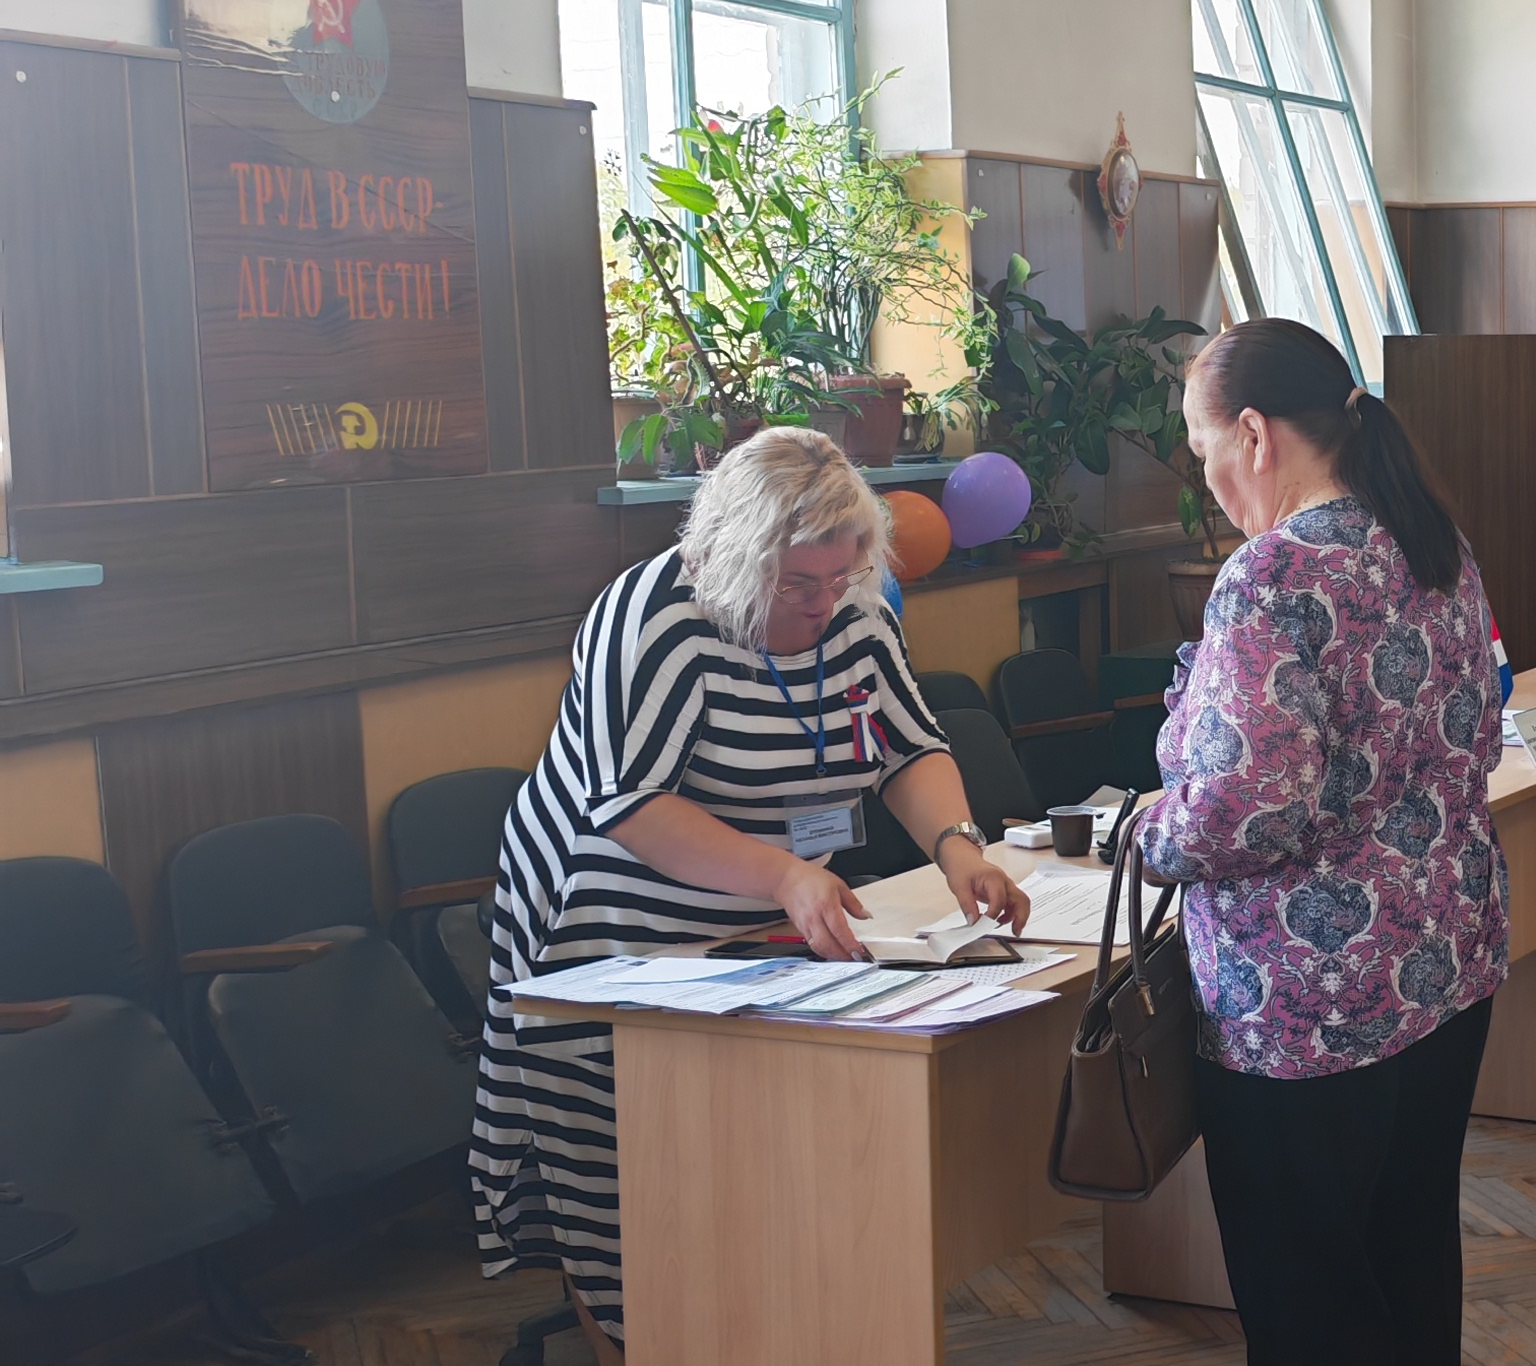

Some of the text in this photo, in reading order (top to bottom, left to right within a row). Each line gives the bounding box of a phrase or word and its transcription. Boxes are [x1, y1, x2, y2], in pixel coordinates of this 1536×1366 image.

[229, 162, 318, 230] ТРУД
[328, 169, 350, 230] В
[238, 255, 322, 321] ДЕЛО
